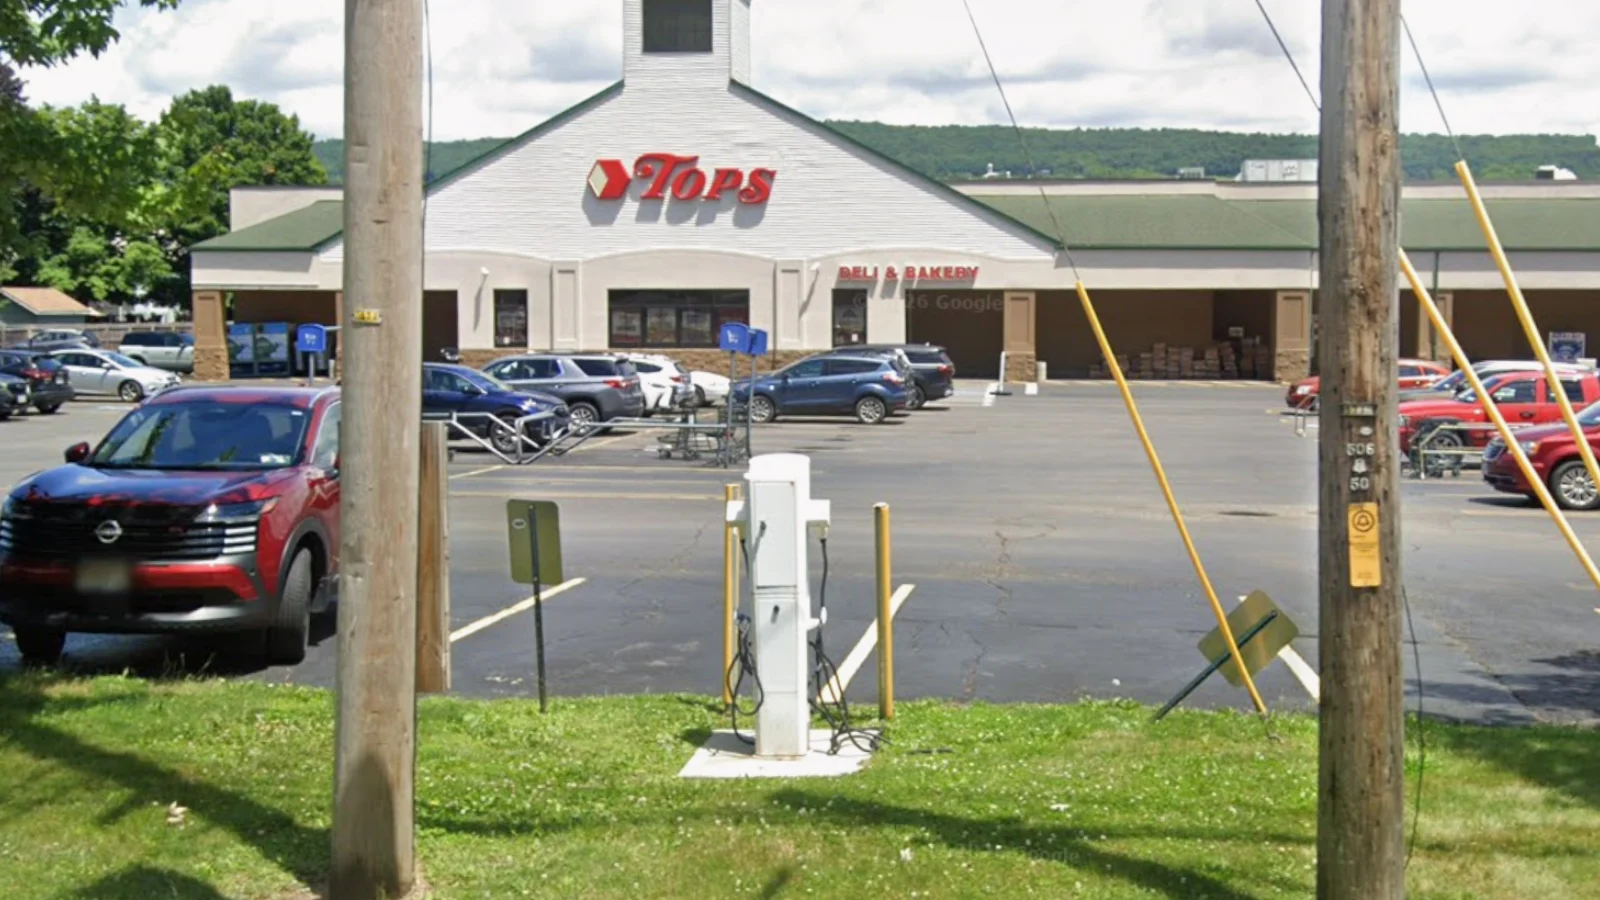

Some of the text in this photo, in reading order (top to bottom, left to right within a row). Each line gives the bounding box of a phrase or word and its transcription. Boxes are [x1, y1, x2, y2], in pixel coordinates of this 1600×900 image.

[634, 153, 777, 204] TOPS
[839, 266, 979, 279] DELI & BAKERY
[1346, 442, 1375, 456] 506
[1350, 477, 1369, 491] 50
